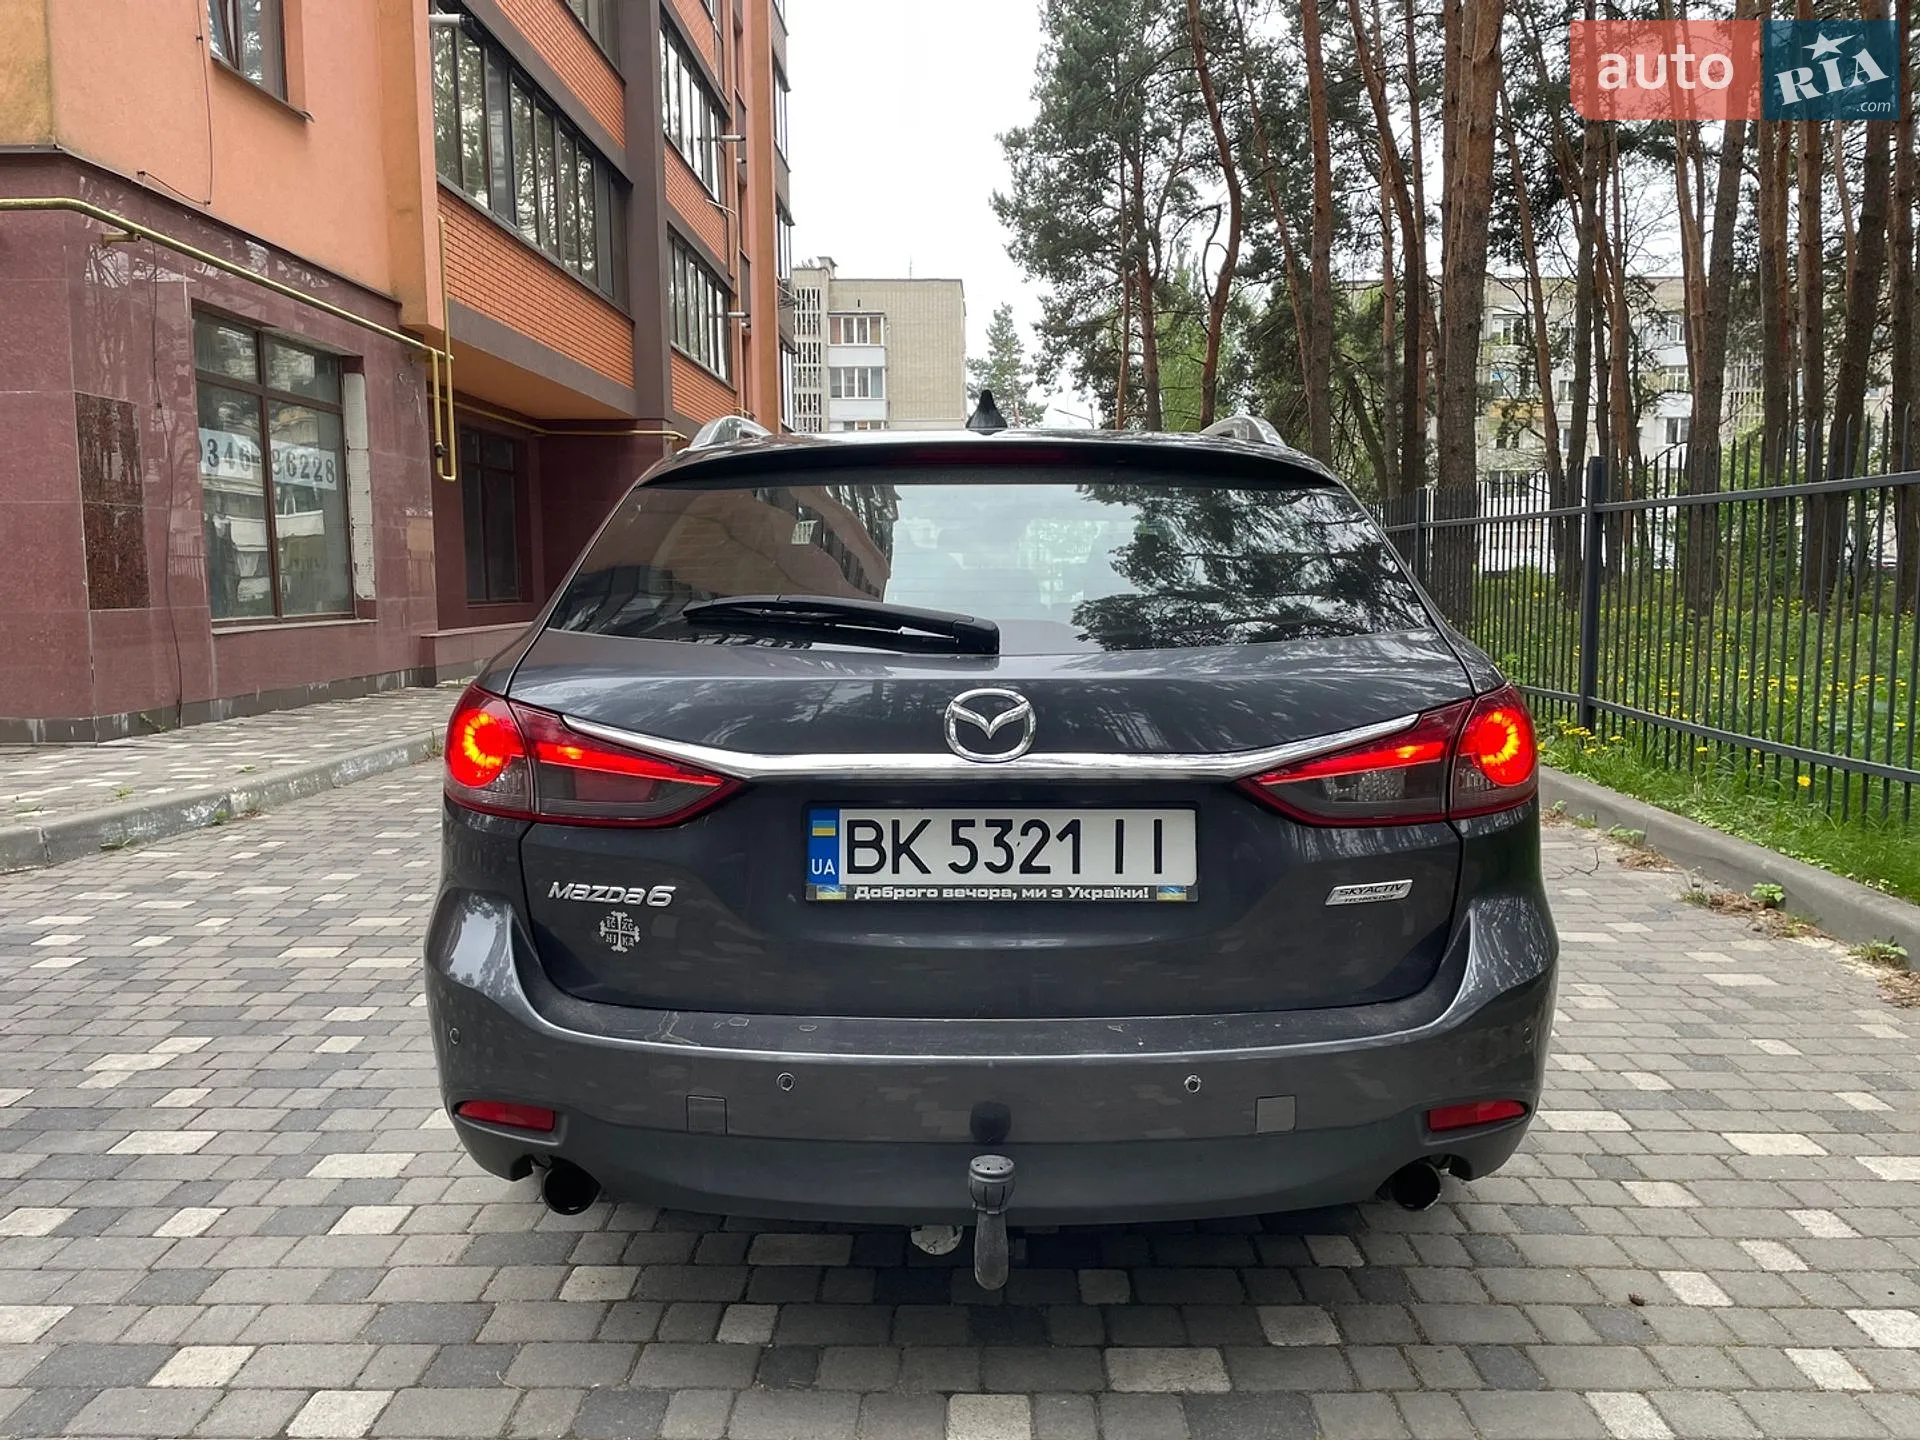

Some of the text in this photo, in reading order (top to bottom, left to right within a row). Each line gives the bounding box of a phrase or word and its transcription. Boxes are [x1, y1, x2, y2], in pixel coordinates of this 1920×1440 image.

[846, 819, 932, 875] BK
[948, 819, 1081, 875] 5321
[811, 858, 836, 875] UA
[854, 886, 939, 900] Доброго
[942, 888, 1018, 900] вечора,
[1021, 888, 1047, 899] ми
[1066, 886, 1150, 900] України!
[1339, 884, 1406, 896] SKYACTIV
